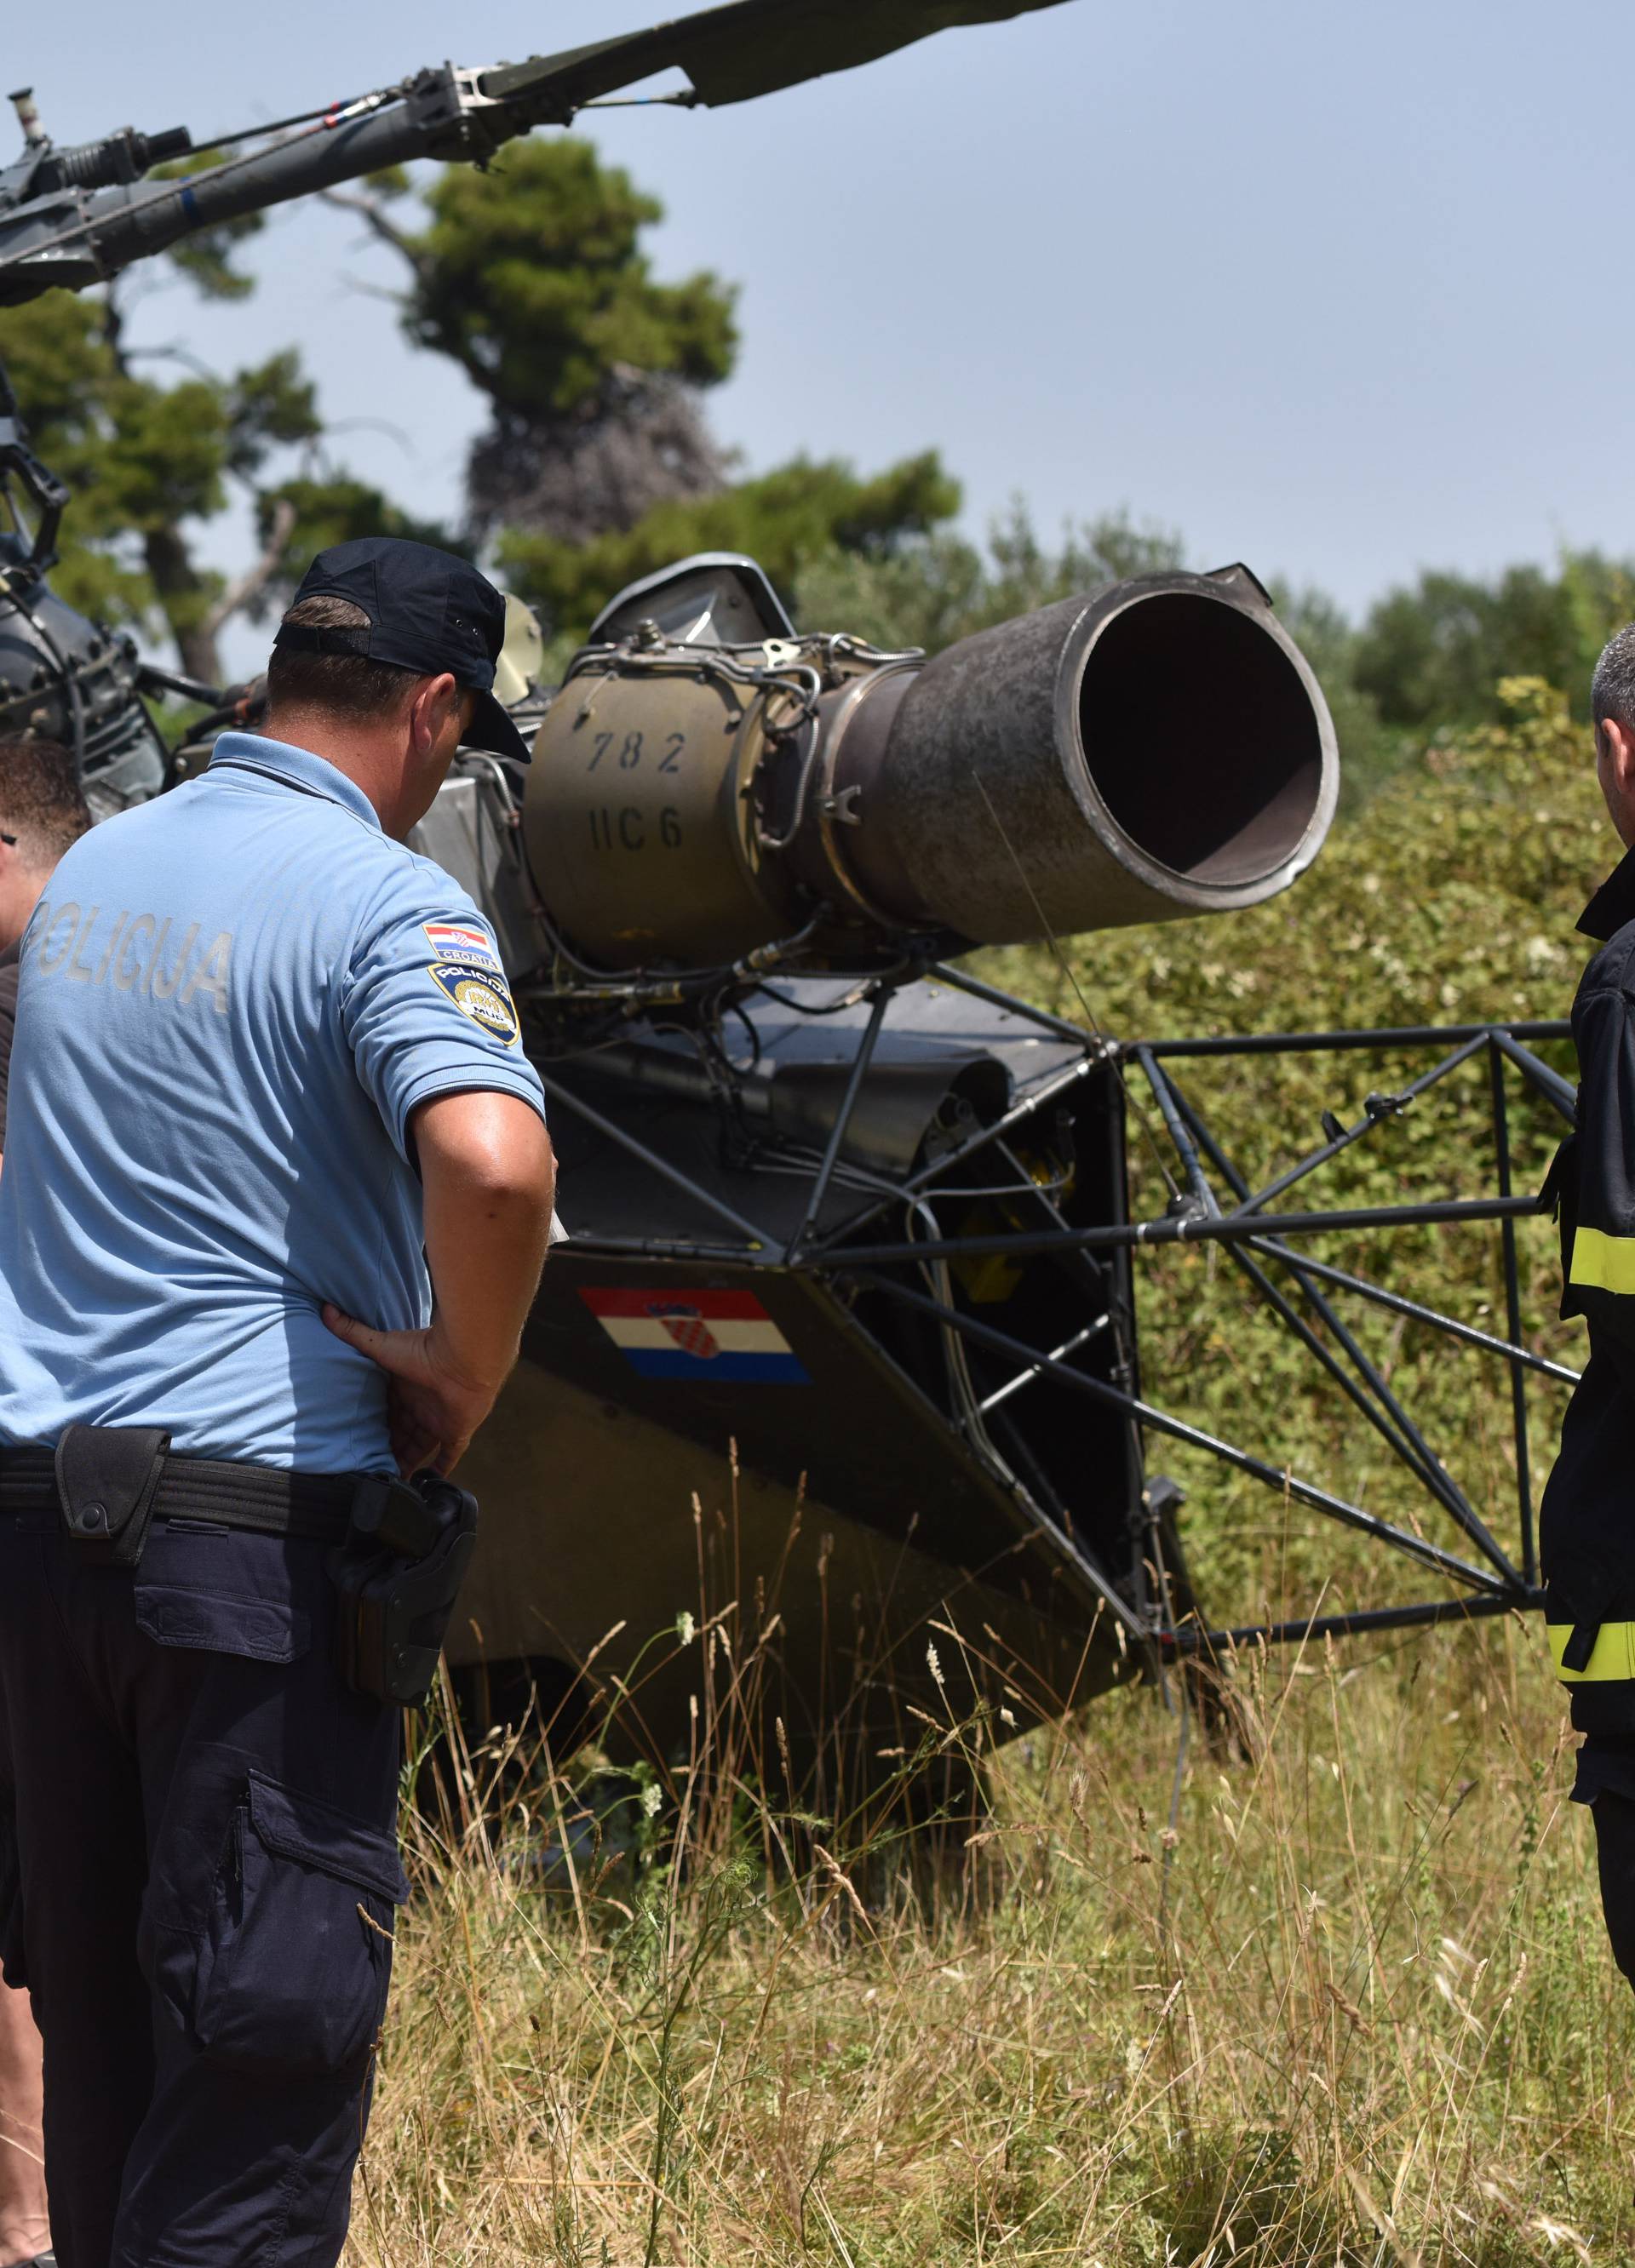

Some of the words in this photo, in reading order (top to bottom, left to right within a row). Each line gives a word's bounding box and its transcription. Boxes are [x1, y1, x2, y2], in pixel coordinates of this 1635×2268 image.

[588, 731, 685, 772] 782
[443, 951, 496, 969] CROATIA
[436, 966, 510, 1002] POLICIJA
[473, 1006, 504, 1022] MUP
